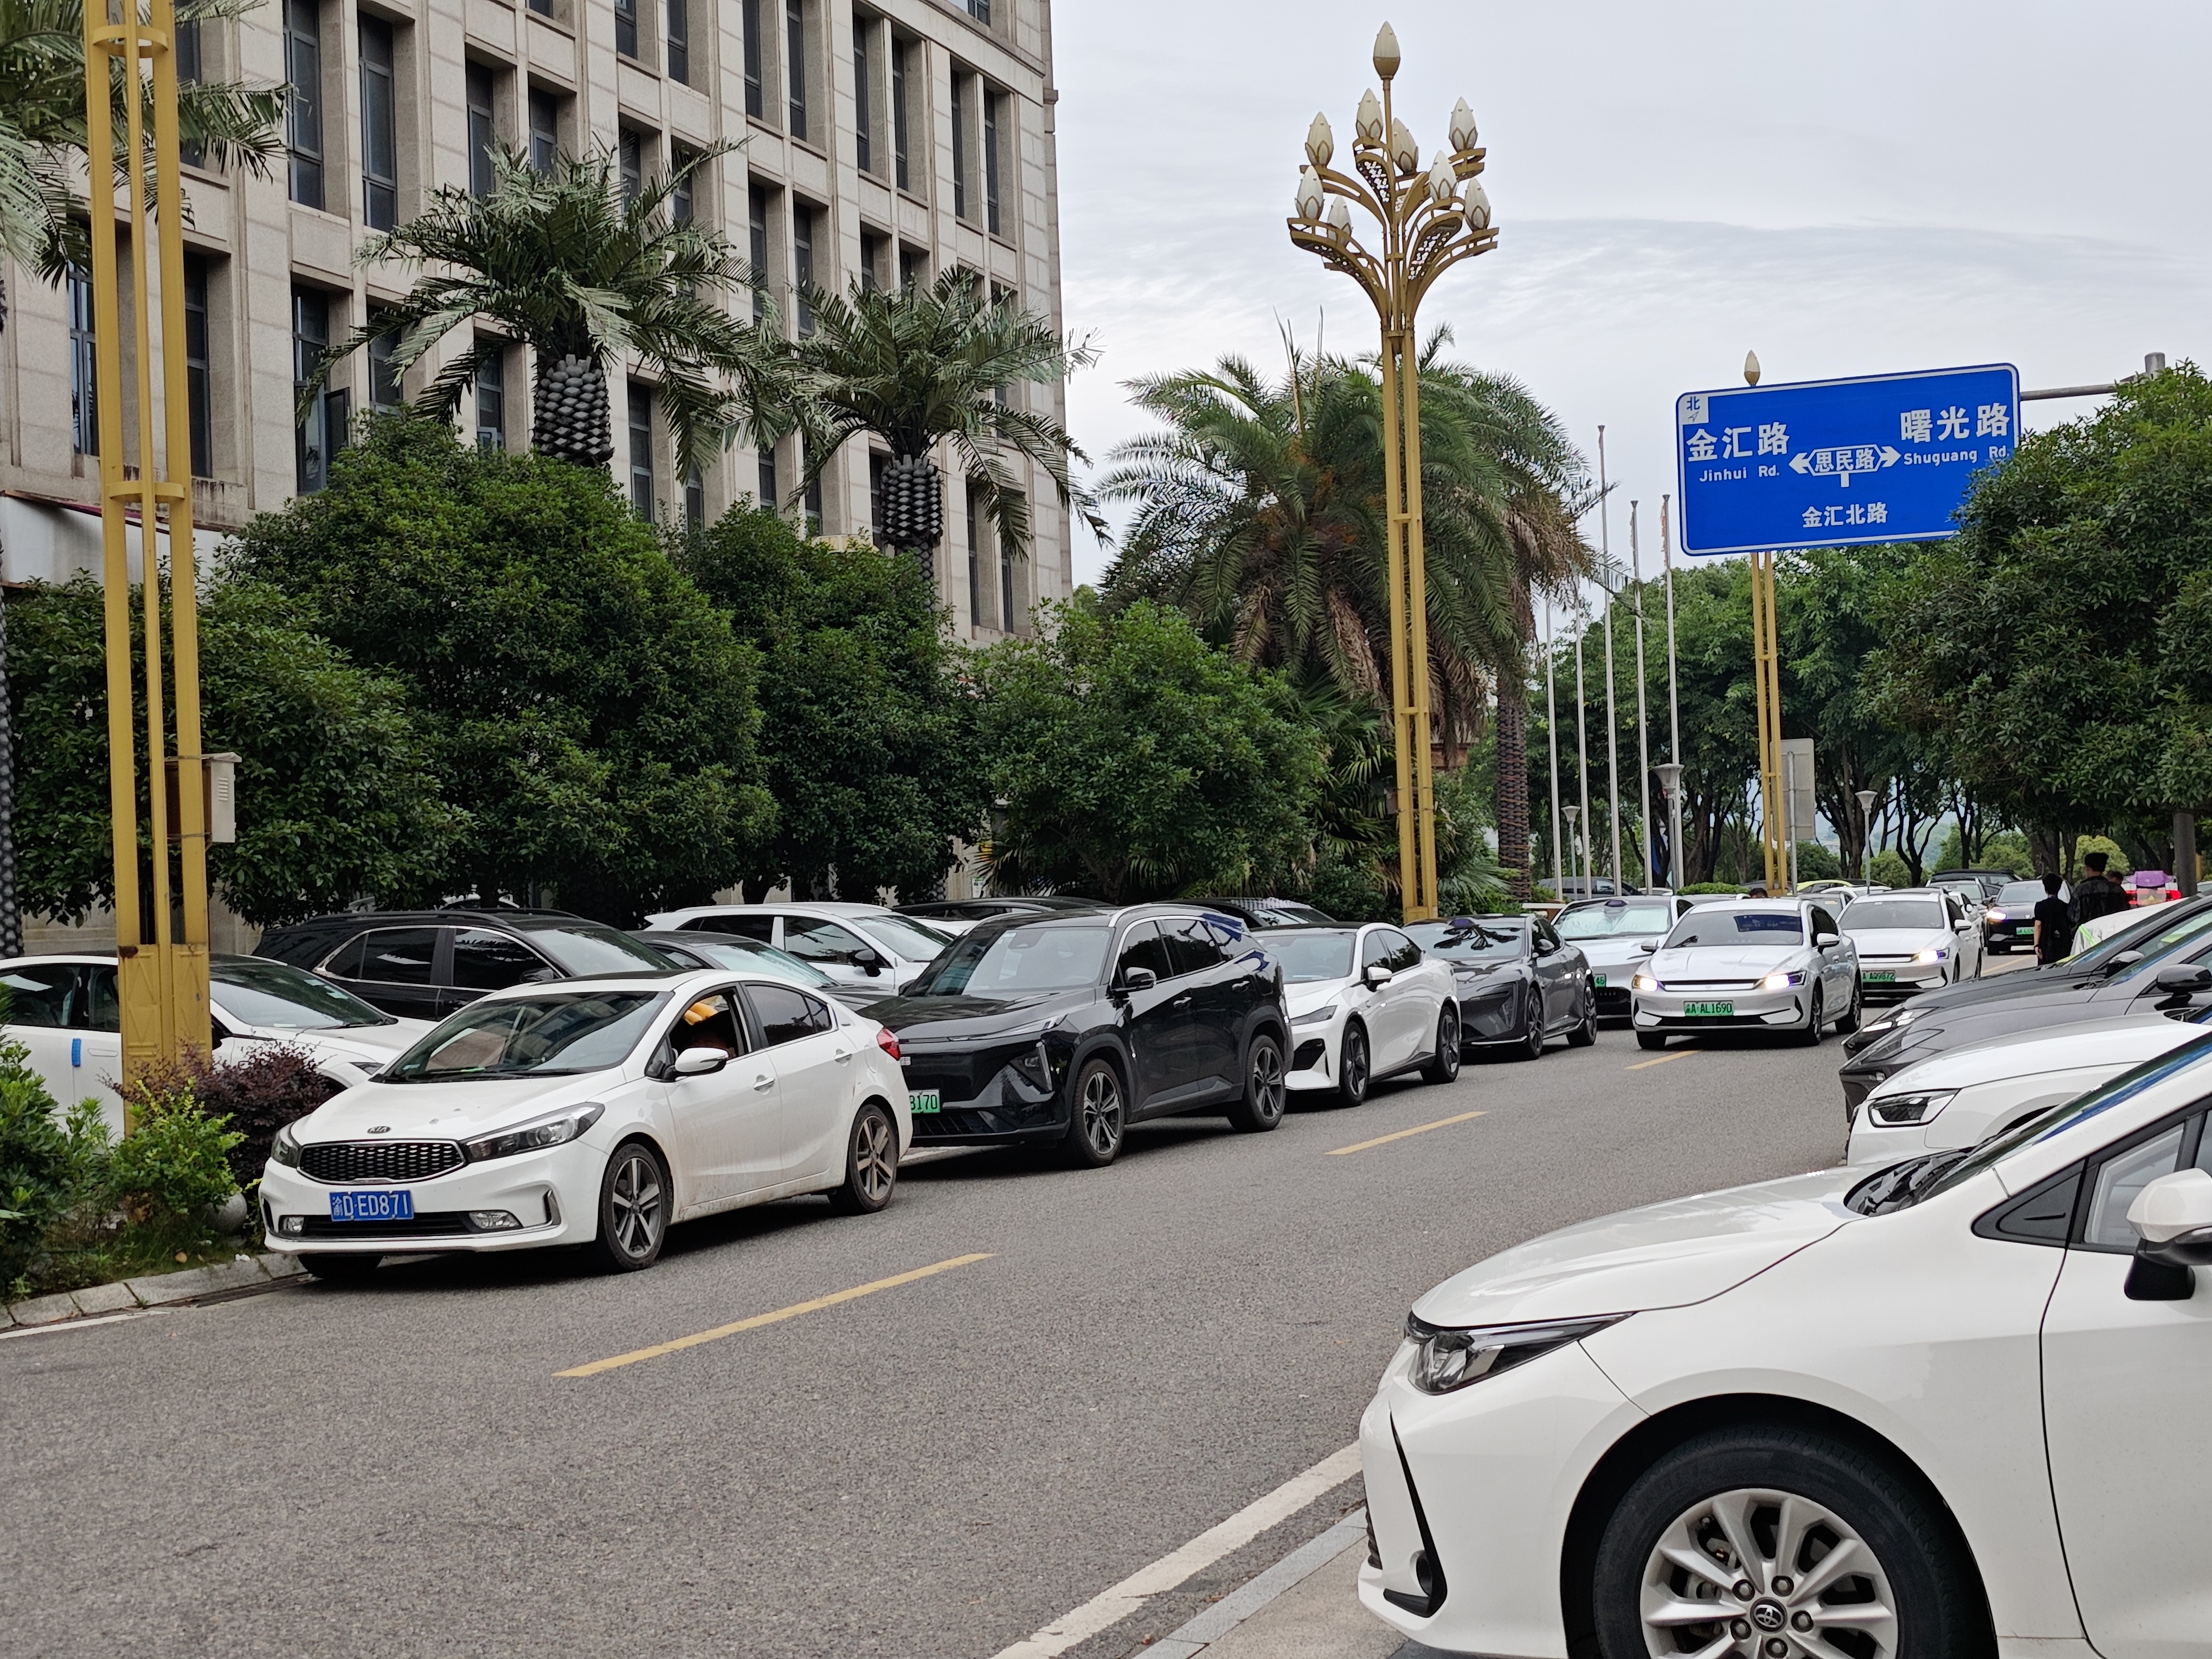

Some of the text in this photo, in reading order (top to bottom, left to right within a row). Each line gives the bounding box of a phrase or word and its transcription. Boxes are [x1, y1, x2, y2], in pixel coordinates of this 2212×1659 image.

[1686, 396, 1700, 411] 北
[1900, 402, 2010, 443] 曙光路
[1686, 421, 1790, 462] 金汇路
[1904, 450, 1978, 467] Shuguang
[1699, 464, 1780, 483] Jinhui Rd.
[1801, 501, 1888, 528] 金汇北路
